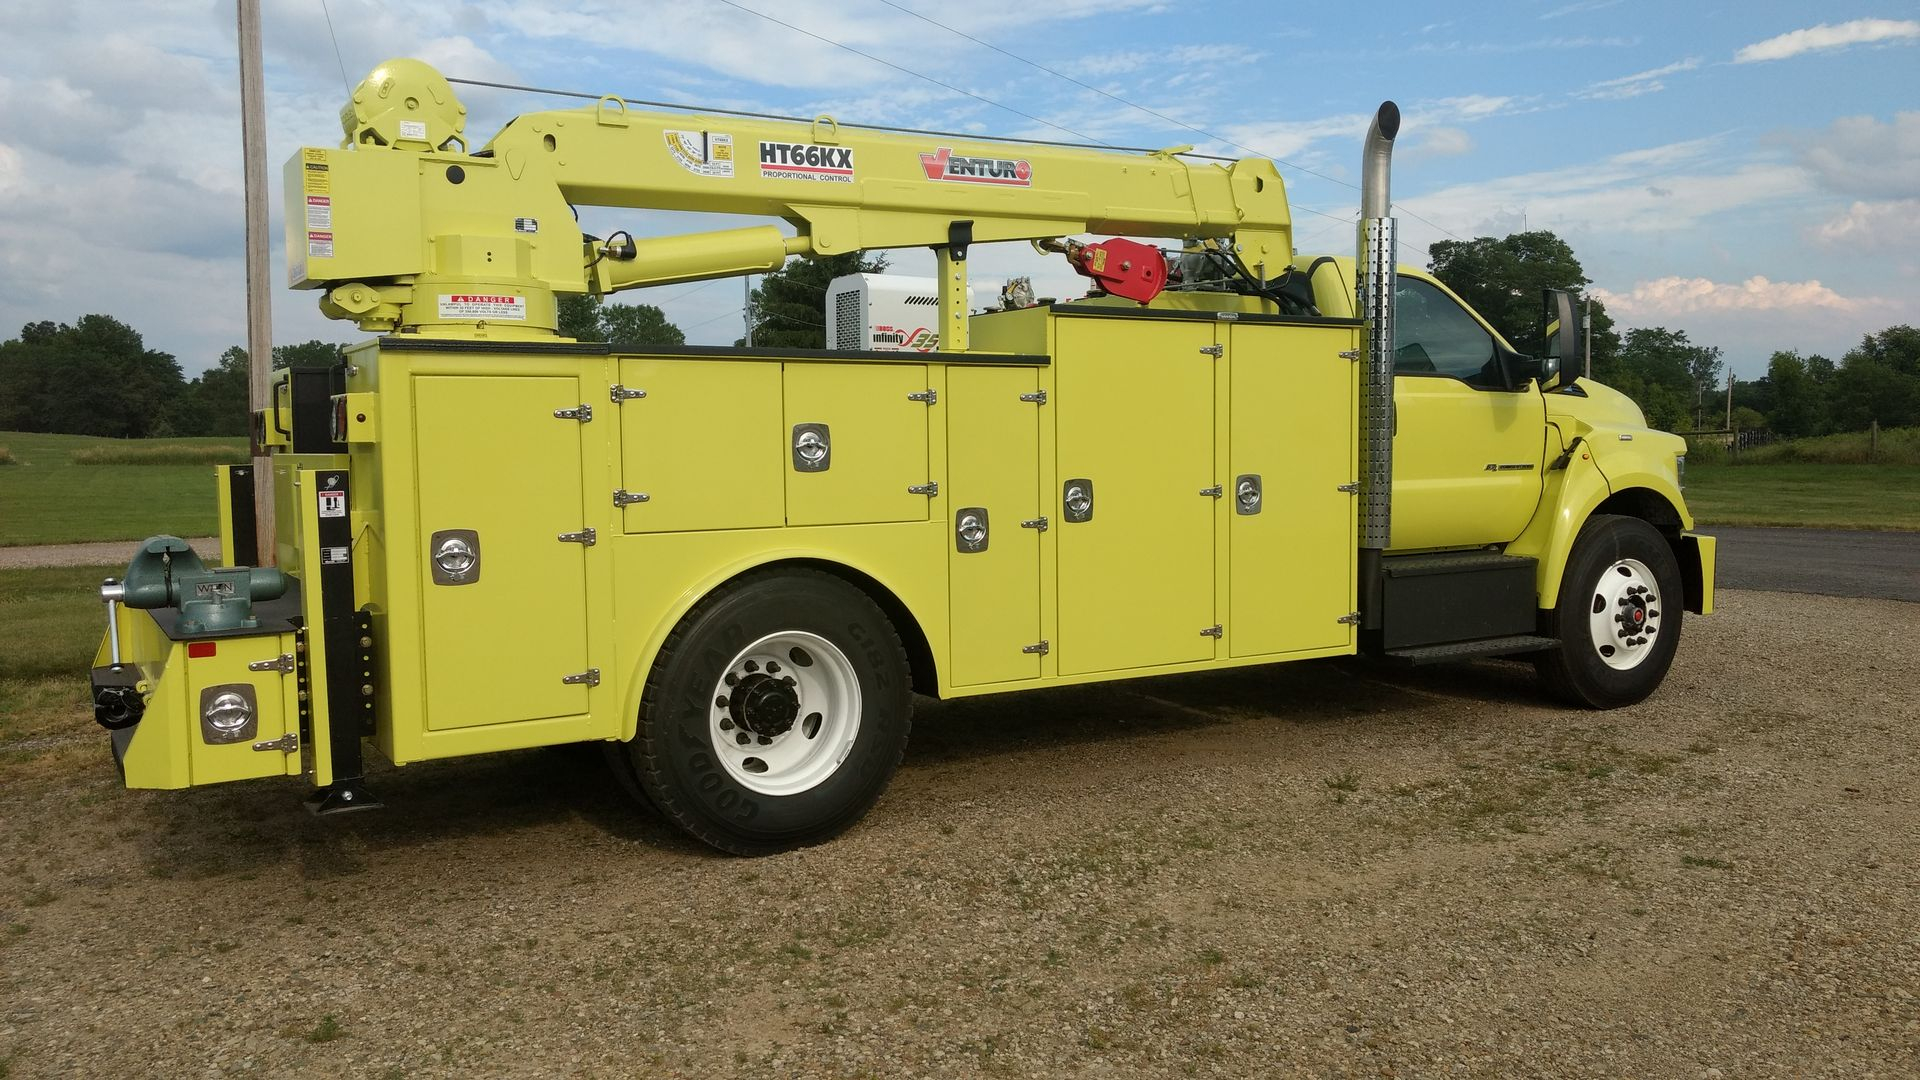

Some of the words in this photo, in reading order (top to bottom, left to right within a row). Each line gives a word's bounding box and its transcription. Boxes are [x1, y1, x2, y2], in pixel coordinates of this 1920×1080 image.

[760, 143, 852, 169] HT66KX
[919, 148, 1031, 180] VENTURO
[763, 170, 816, 180] PROPORTIONAL
[819, 174, 852, 183] CONTROL
[911, 334, 939, 348] 35
